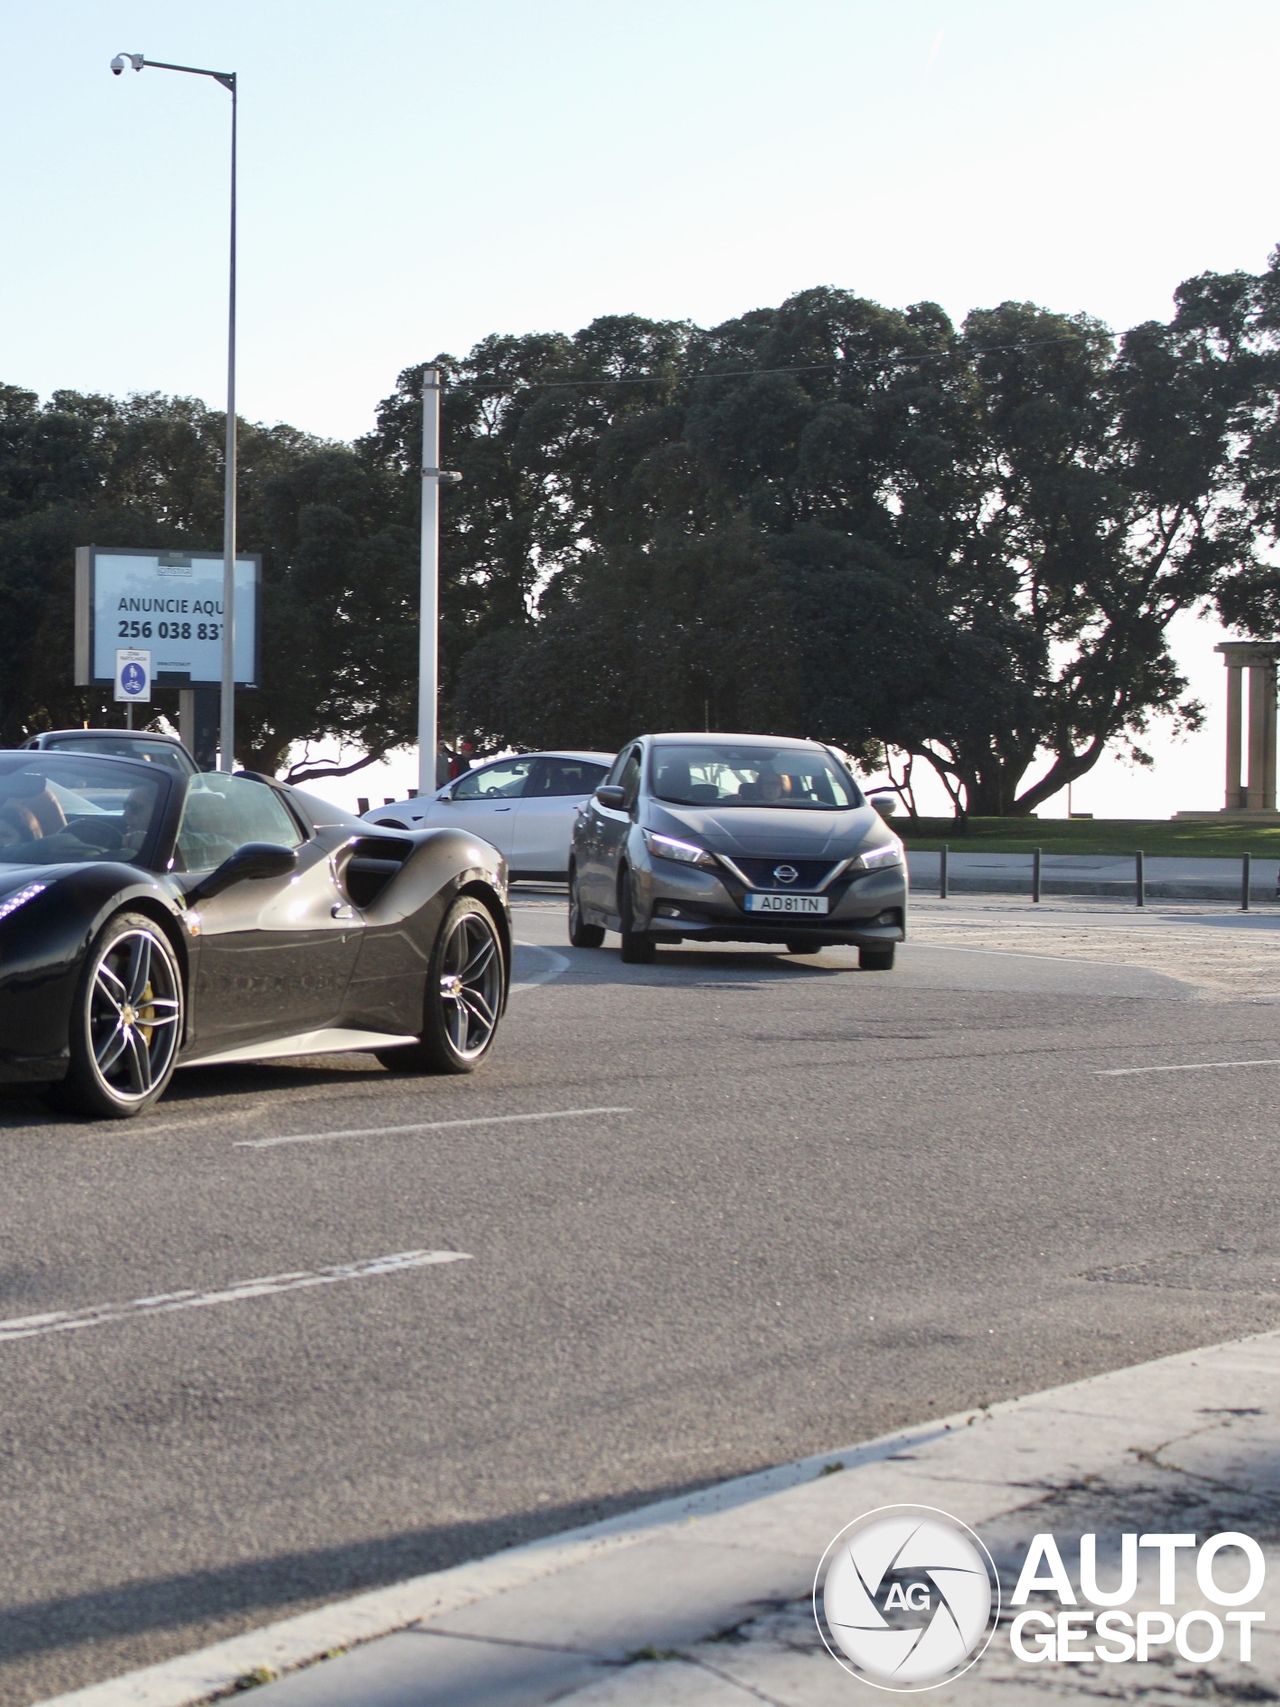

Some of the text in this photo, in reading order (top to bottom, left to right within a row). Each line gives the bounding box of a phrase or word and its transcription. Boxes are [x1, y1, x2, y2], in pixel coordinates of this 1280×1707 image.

[118, 597, 188, 614] ANUNCIE
[118, 620, 152, 638] 256
[158, 621, 192, 639] 038
[760, 896, 818, 911] AD81TN
